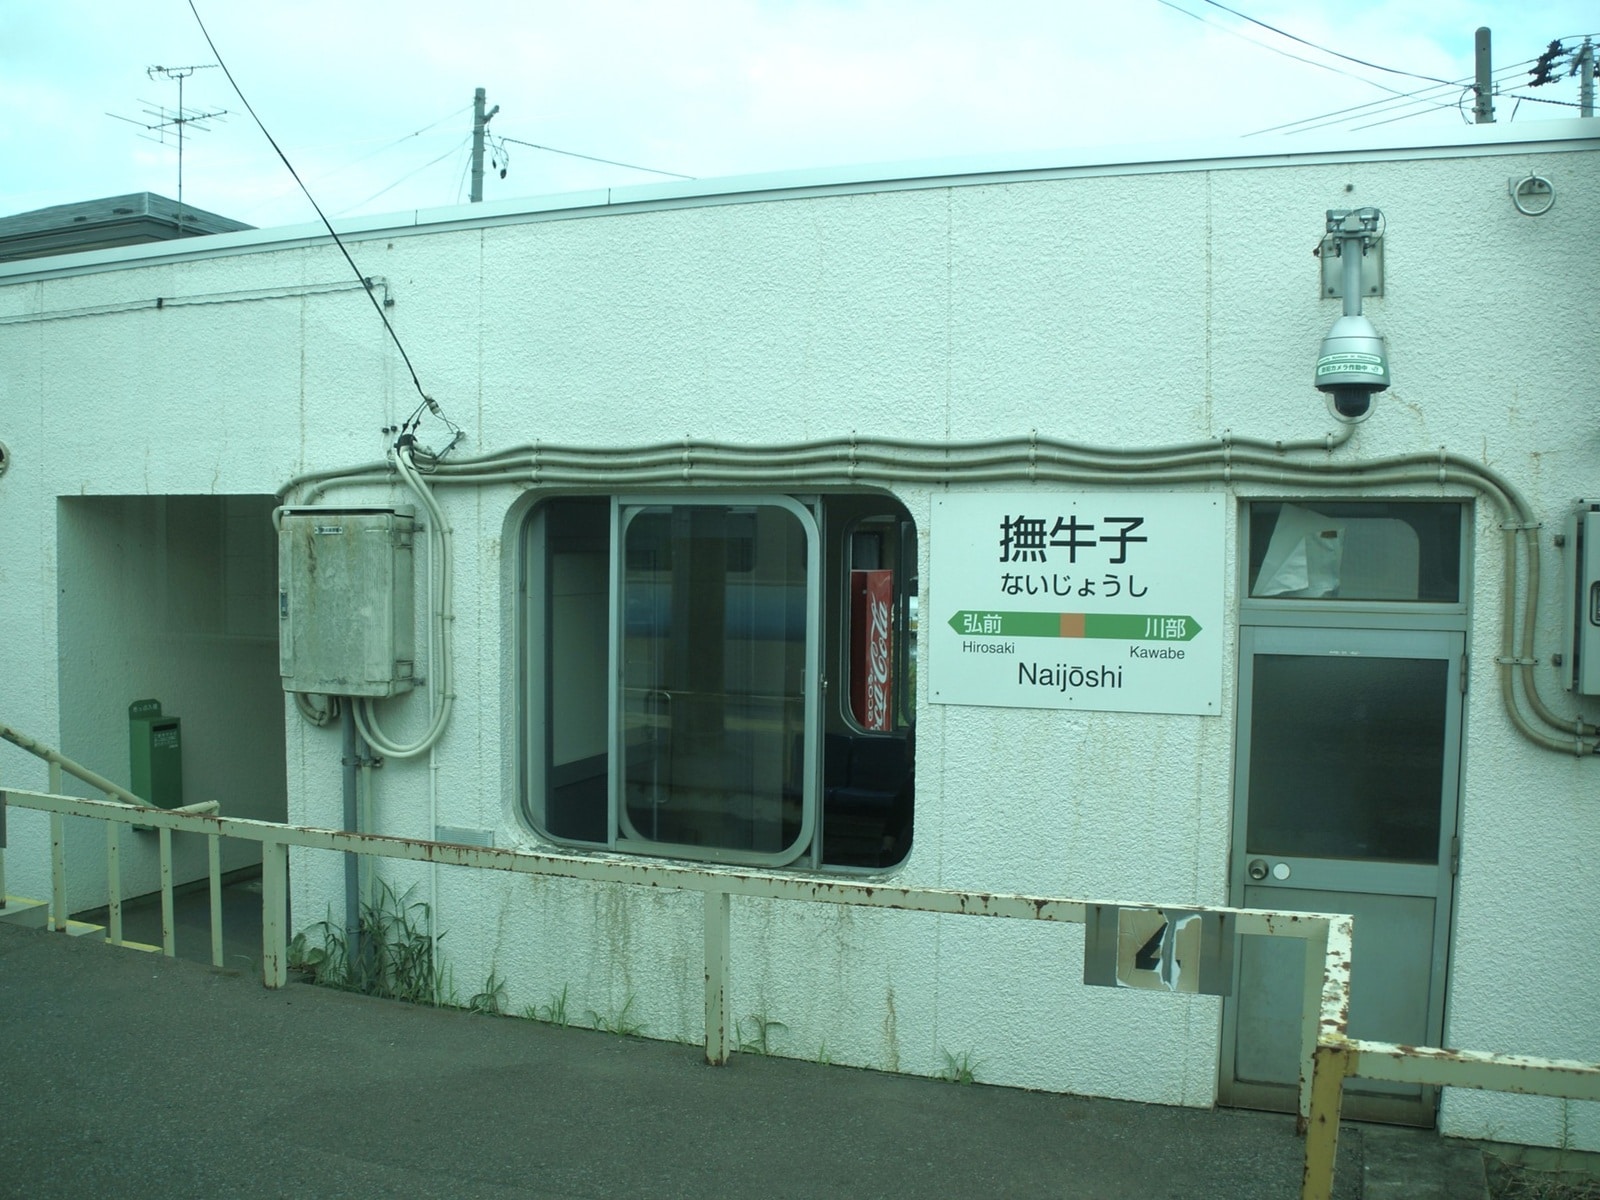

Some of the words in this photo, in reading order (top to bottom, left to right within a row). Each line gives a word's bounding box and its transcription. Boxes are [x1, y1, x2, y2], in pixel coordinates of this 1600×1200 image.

[999, 515, 1148, 564] 撫牛子
[1001, 573, 1148, 598] ないじょうし
[963, 614, 1002, 634] 弘前
[1145, 618, 1186, 639] 川部
[963, 641, 1015, 654] Hirosaki
[1130, 646, 1185, 660] Kawabe
[870, 591, 888, 731] ca-Cola
[1018, 662, 1122, 692] Naijōshi
